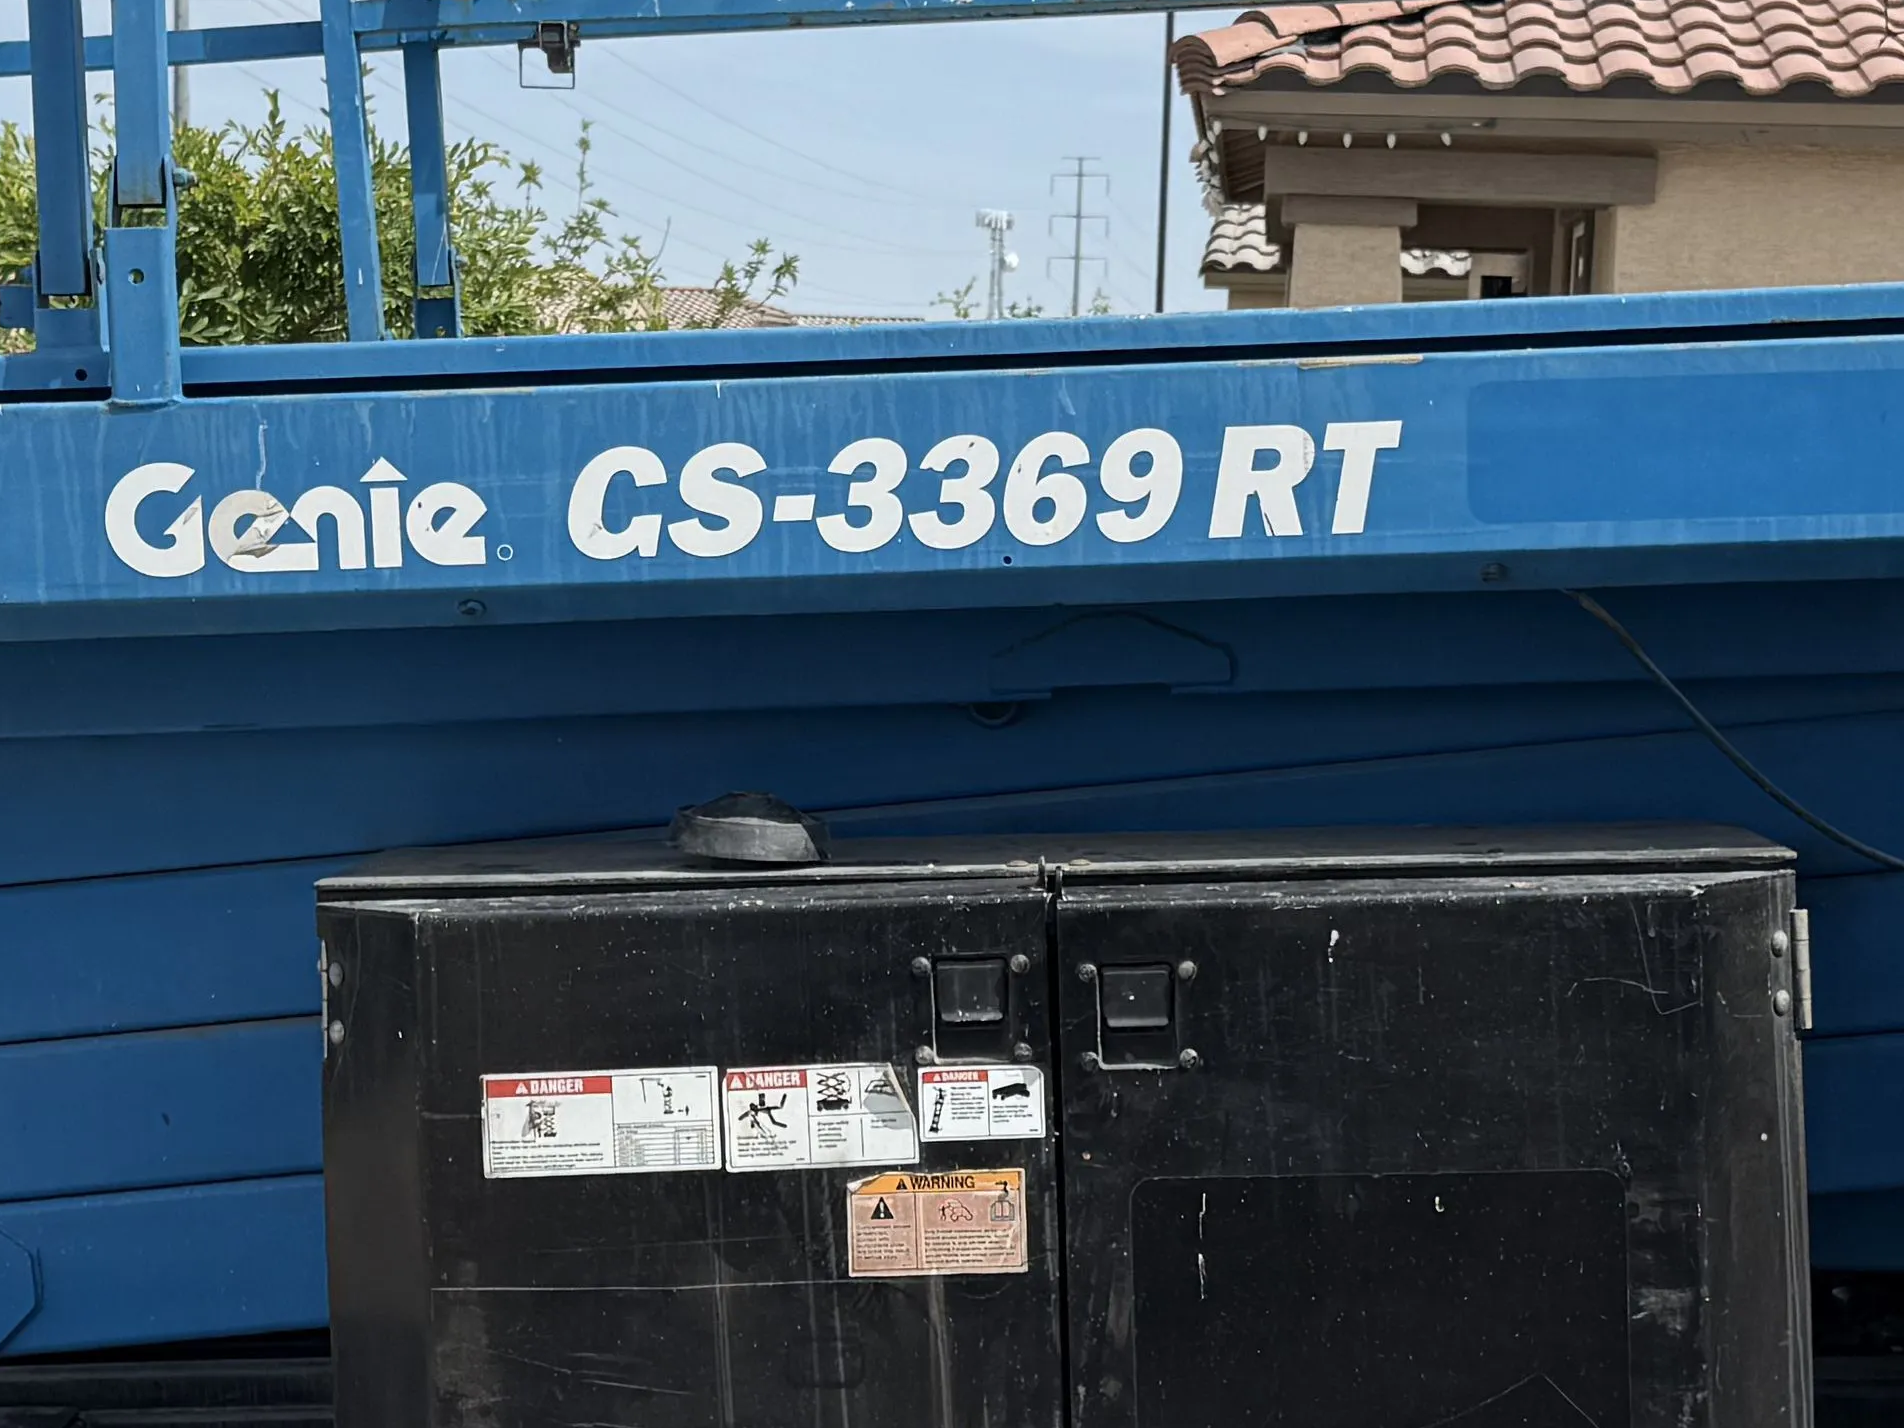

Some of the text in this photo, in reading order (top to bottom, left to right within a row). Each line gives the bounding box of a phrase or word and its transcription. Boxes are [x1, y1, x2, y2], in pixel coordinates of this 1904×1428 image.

[104, 419, 1404, 578] Genie GS-3369 RT
[529, 1078, 584, 1094] DANGER
[745, 1073, 802, 1089] DANGER
[909, 1175, 976, 1191] WARNING
